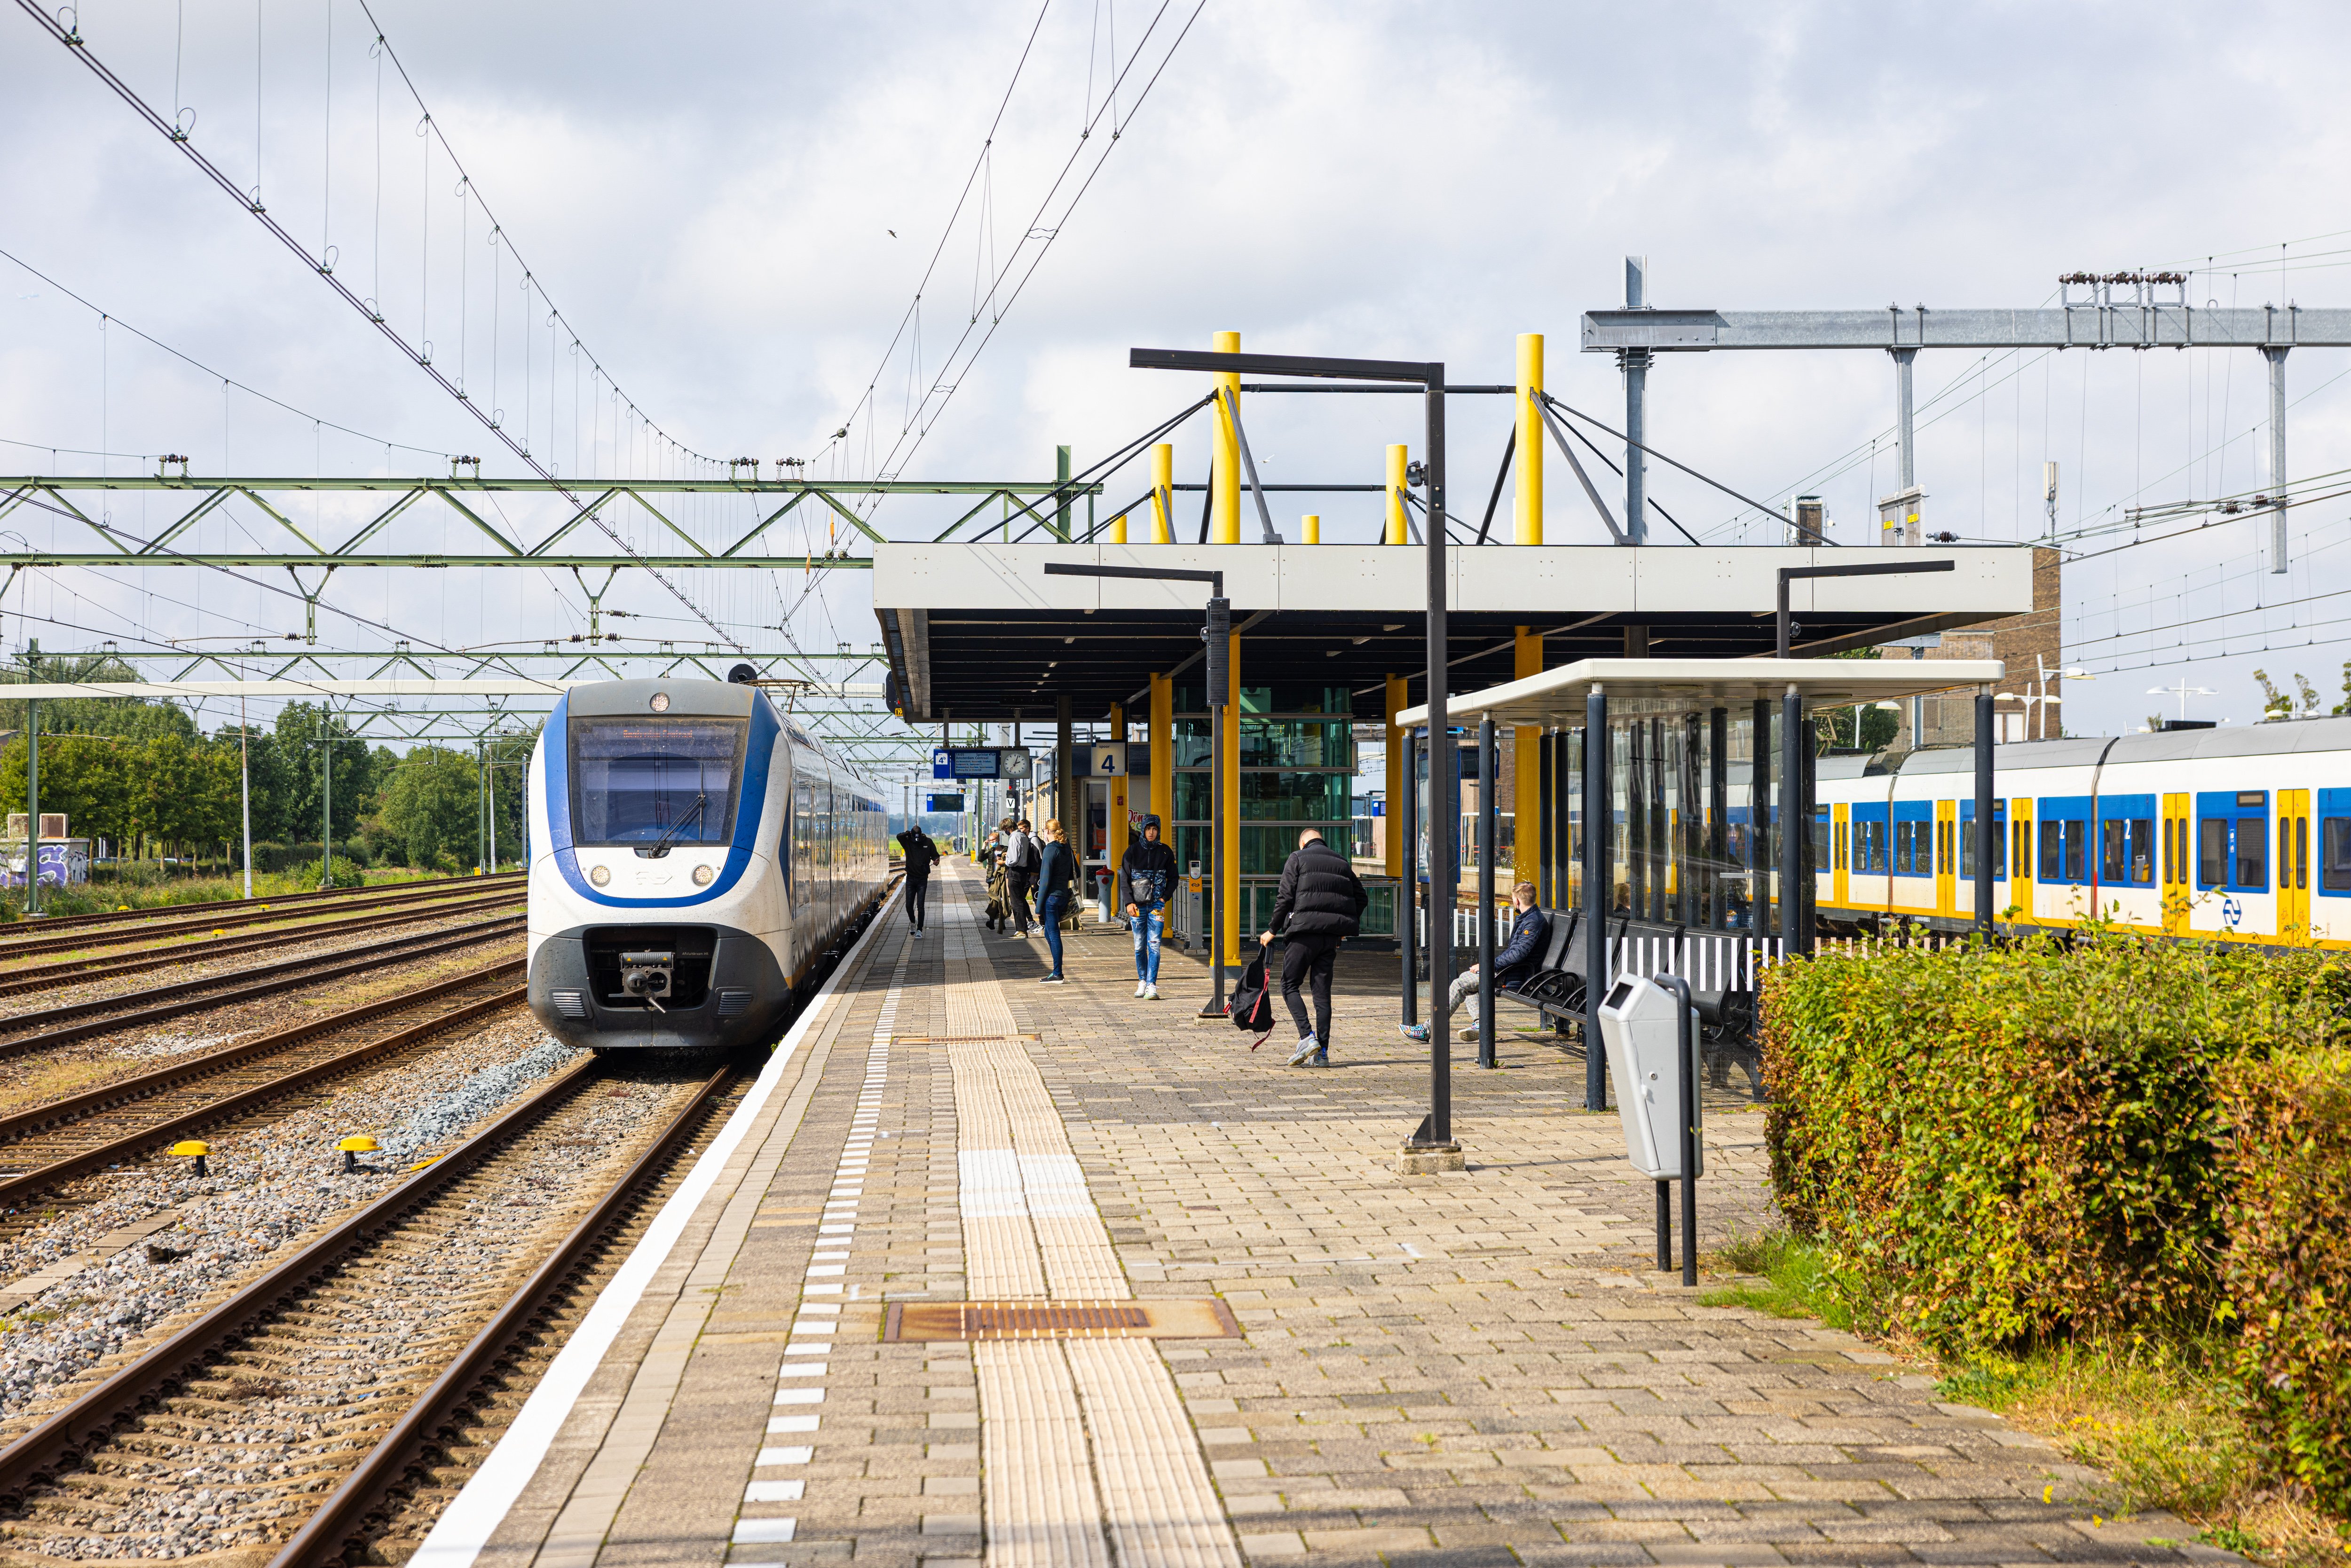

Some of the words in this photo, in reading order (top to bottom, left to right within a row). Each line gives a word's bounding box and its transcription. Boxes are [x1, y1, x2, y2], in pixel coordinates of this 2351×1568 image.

[1101, 755, 1115, 773] 4
[1128, 809, 1143, 823] Dön
[1867, 821, 1870, 837] 2
[1911, 820, 1915, 837] 2
[2059, 819, 2065, 839] 2
[2125, 819, 2130, 839] 2
